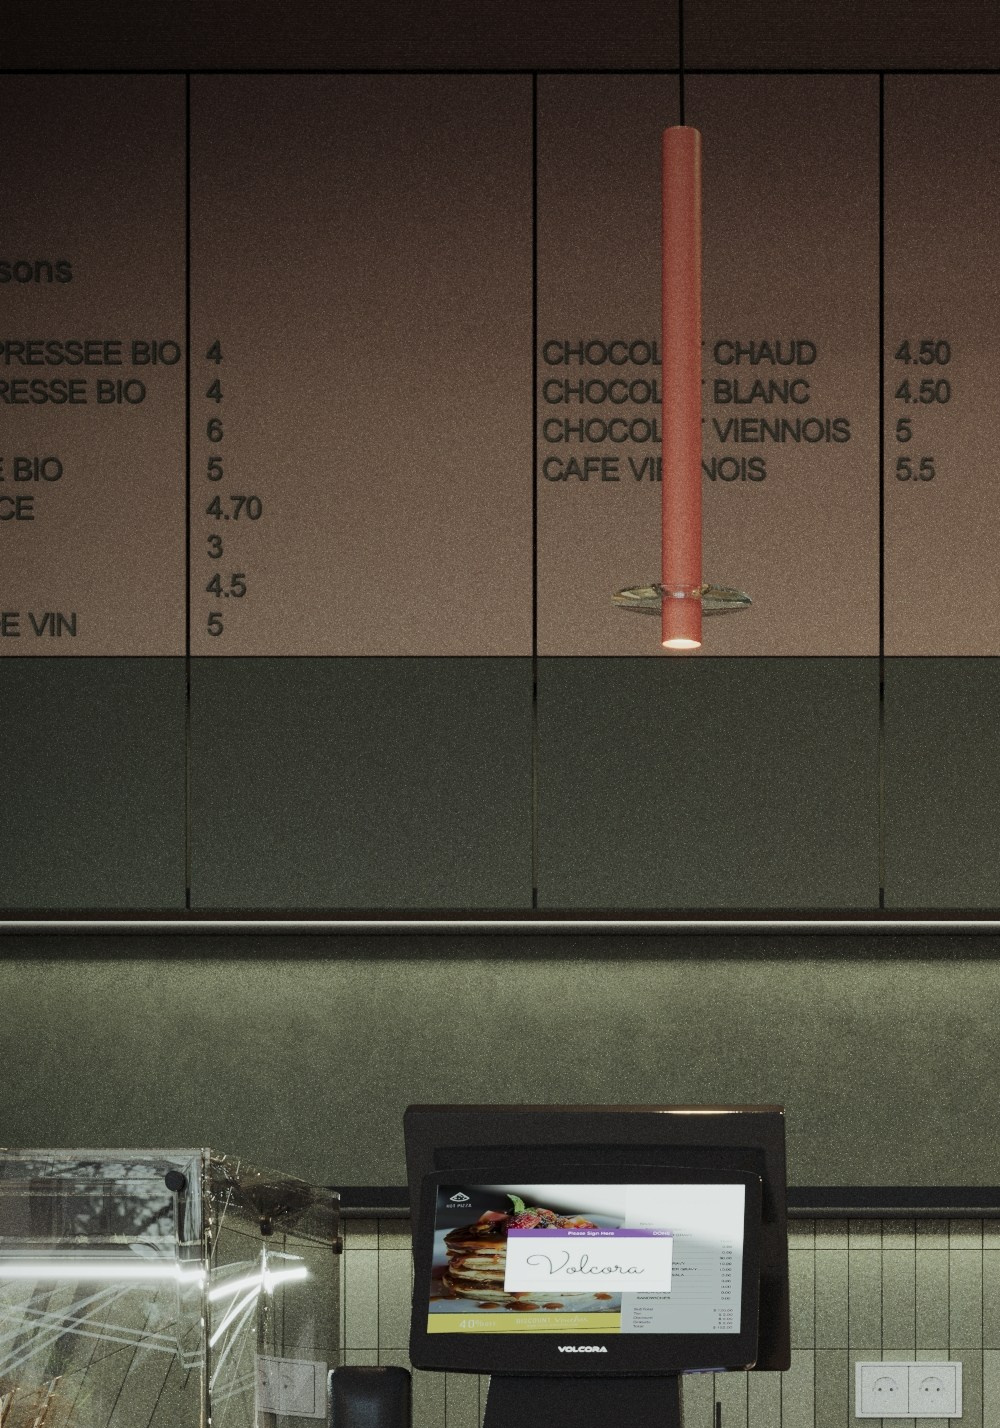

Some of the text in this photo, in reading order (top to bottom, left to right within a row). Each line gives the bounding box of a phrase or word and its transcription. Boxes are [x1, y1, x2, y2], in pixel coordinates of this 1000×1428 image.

[132, 340, 181, 365] BIO
[206, 340, 223, 364] 4
[542, 340, 951, 365] CHOCOL CHAUD 4.50
[97, 379, 146, 404] BIO
[206, 379, 223, 403] 4
[542, 378, 951, 405] CHOCOL BLANC 4.50
[207, 418, 223, 442] 6
[543, 417, 912, 444] CHOCOL VIENNOIS 5
[14, 457, 63, 482] BIO
[207, 456, 223, 481] 5
[542, 457, 935, 482] CAFE VINOIS 5.5
[206, 495, 263, 520] 4.70
[207, 534, 223, 559] 3
[206, 573, 247, 598] 4.5
[28, 612, 77, 637] VIN
[207, 612, 224, 636] 5
[526, 1250, 645, 1275] Volcora
